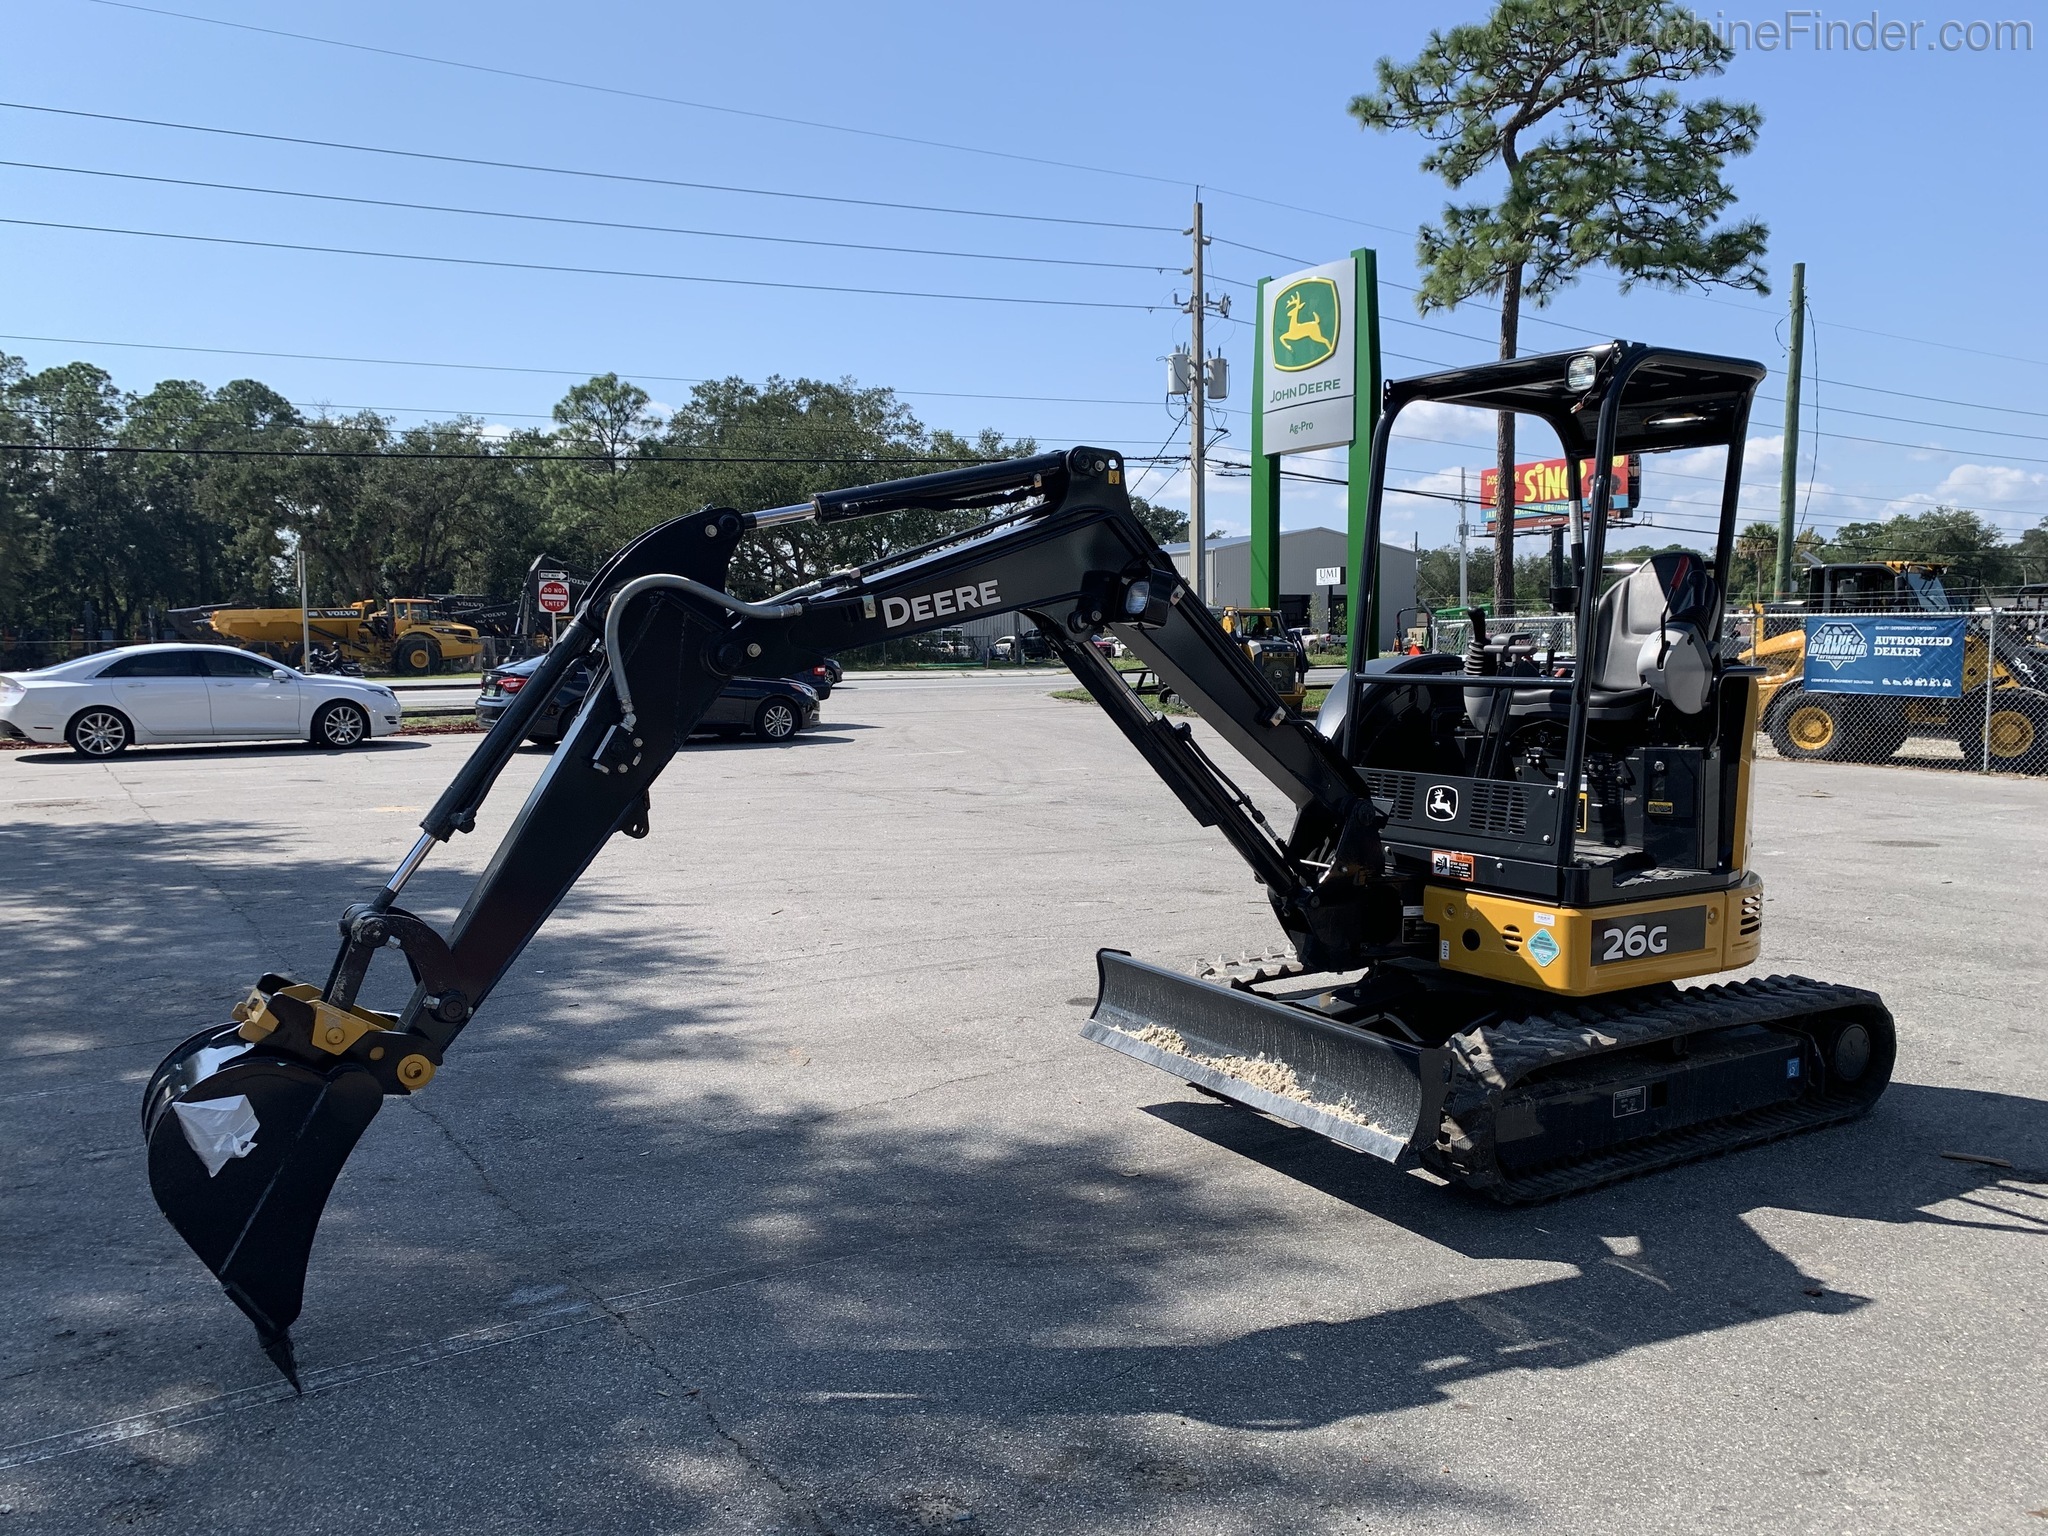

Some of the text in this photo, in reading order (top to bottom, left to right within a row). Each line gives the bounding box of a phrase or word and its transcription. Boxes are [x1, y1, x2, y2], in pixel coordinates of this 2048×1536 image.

[1270, 378, 1341, 403] JOHN DEERE
[1289, 421, 1314, 434] Ag-Pro
[1319, 568, 1337, 579] UMI
[881, 579, 1002, 629] DEERE
[481, 611, 507, 619] VOLVO
[1823, 634, 1855, 644] BLUE
[1874, 636, 1953, 646] AUTHORIZED
[1810, 643, 1867, 655] DIAMOND
[1874, 647, 1922, 657] DEALER
[1603, 924, 1668, 961] 26G
